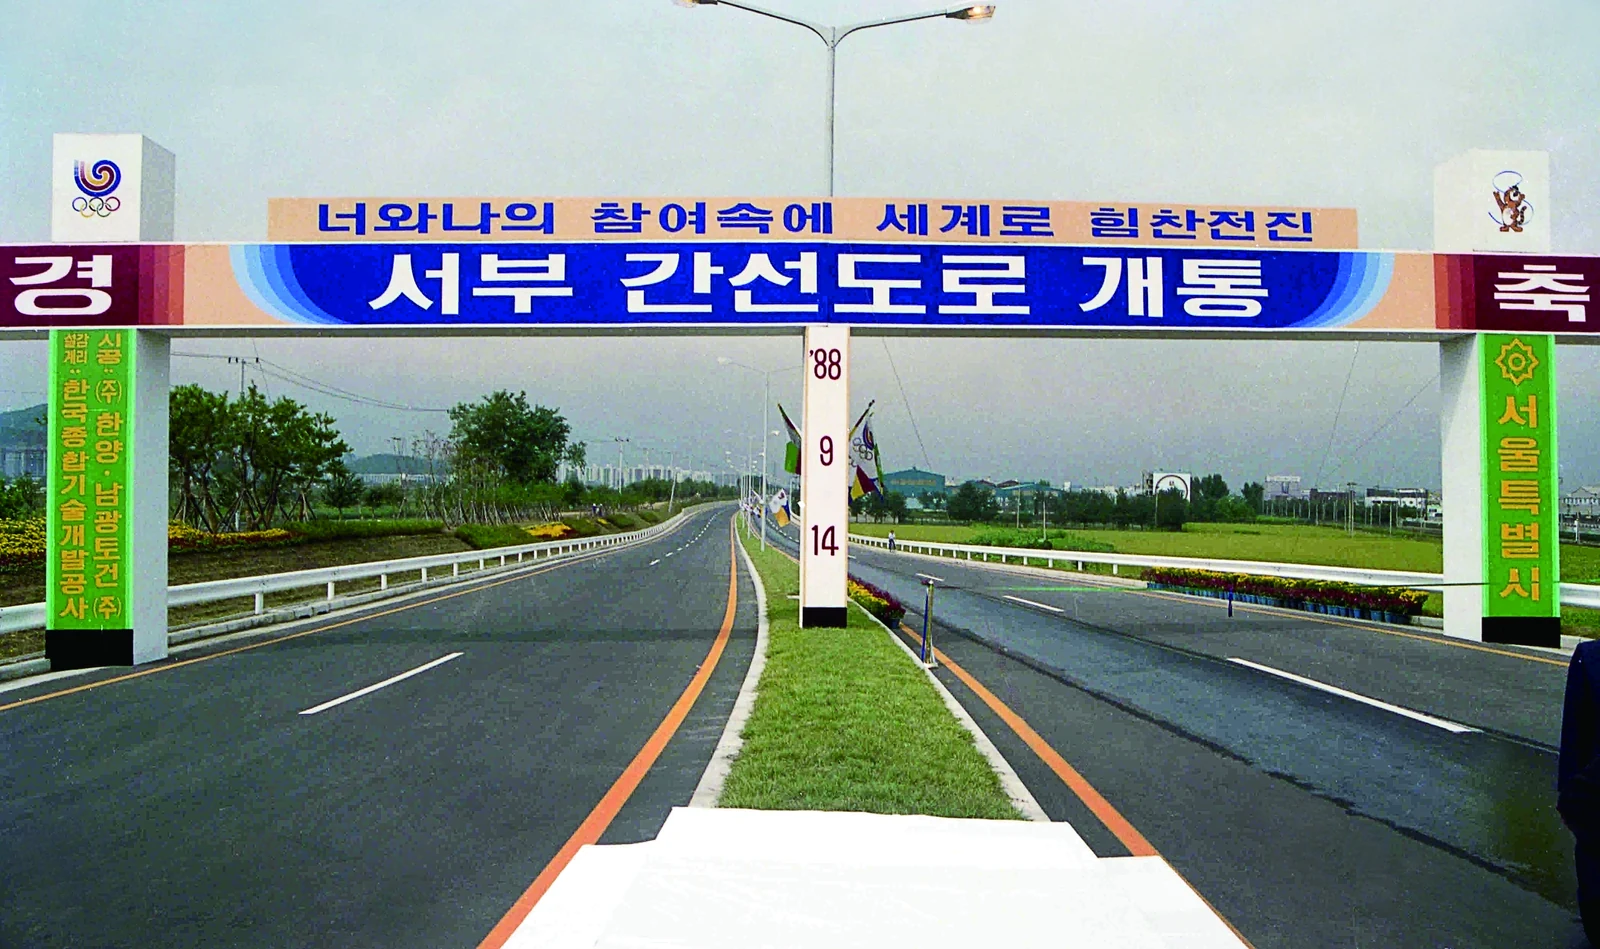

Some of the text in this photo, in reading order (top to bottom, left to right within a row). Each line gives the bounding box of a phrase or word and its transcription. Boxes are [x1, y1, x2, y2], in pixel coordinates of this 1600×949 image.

[318, 201, 1313, 242] 너와나의 참여속에 세계로 힘찬전진
[9, 254, 113, 317] 경
[368, 251, 1269, 318] 서부 간선도로 개통
[1493, 264, 1590, 322] 축
[819, 435, 834, 467] 9
[1497, 394, 1542, 601] 서울특별시
[811, 524, 840, 557] 14
